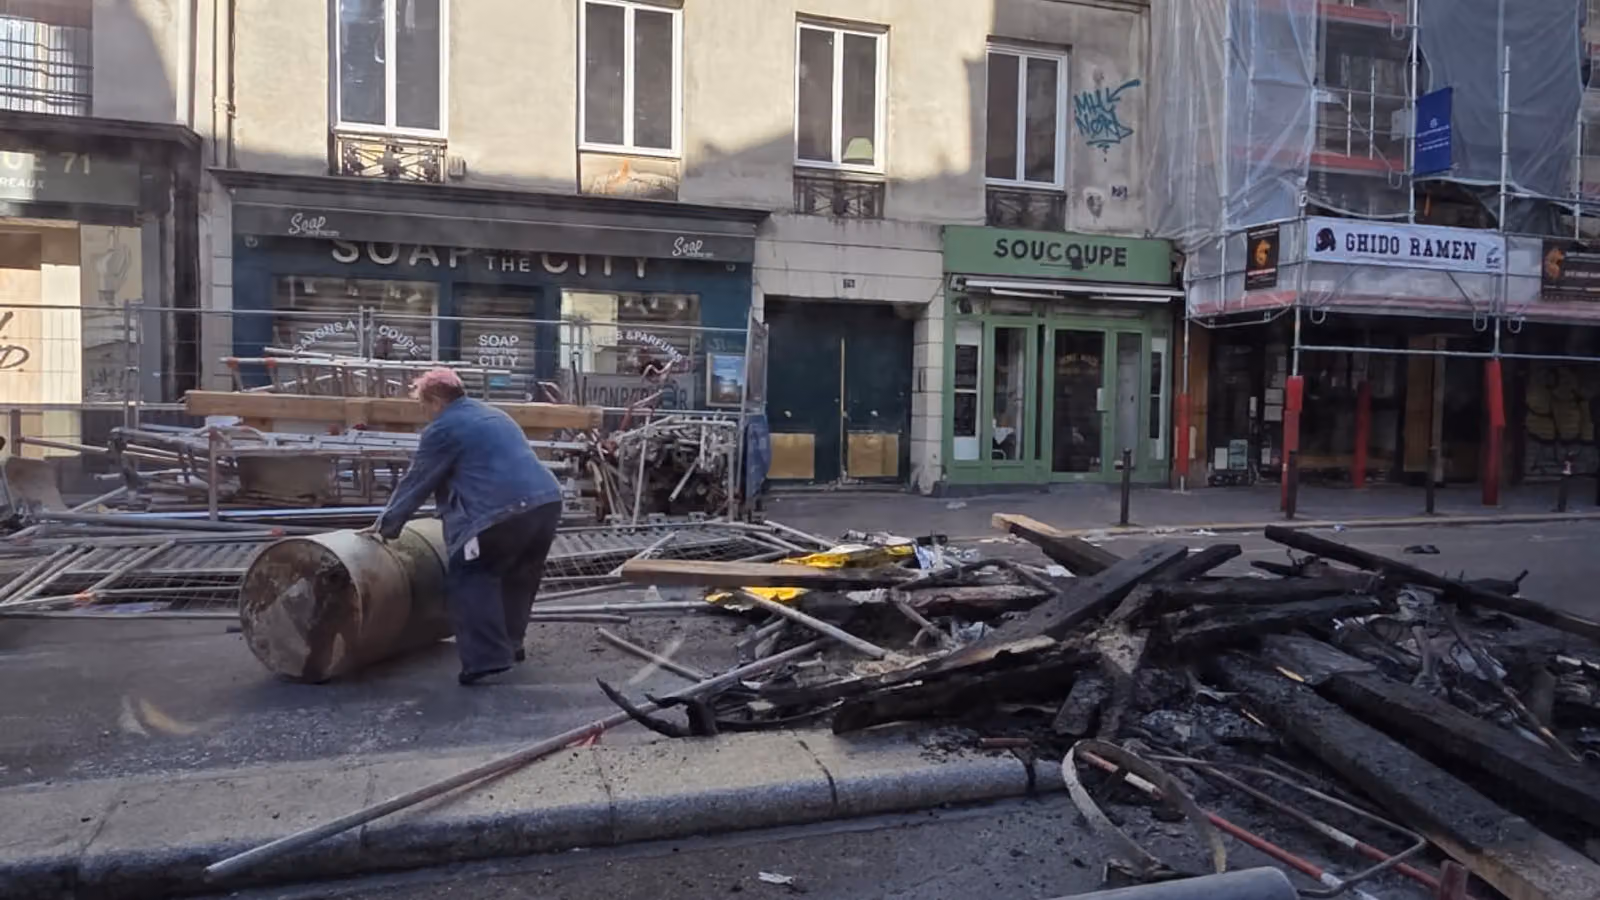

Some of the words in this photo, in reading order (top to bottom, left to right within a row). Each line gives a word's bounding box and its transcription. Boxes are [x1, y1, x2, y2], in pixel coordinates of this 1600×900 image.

[60, 151, 92, 175] 71
[288, 212, 326, 237] Soap
[672, 236, 703, 257] Soap
[993, 238, 1128, 268] SOUCOUPE
[1345, 232, 1400, 256] GHIDO
[1409, 238, 1477, 261] RAMEN
[484, 255, 532, 273] THE
[292, 321, 344, 353] SAVONS
[378, 324, 420, 356] COUPE
[479, 334, 520, 347] SOAP
[479, 354, 520, 368] CITY
